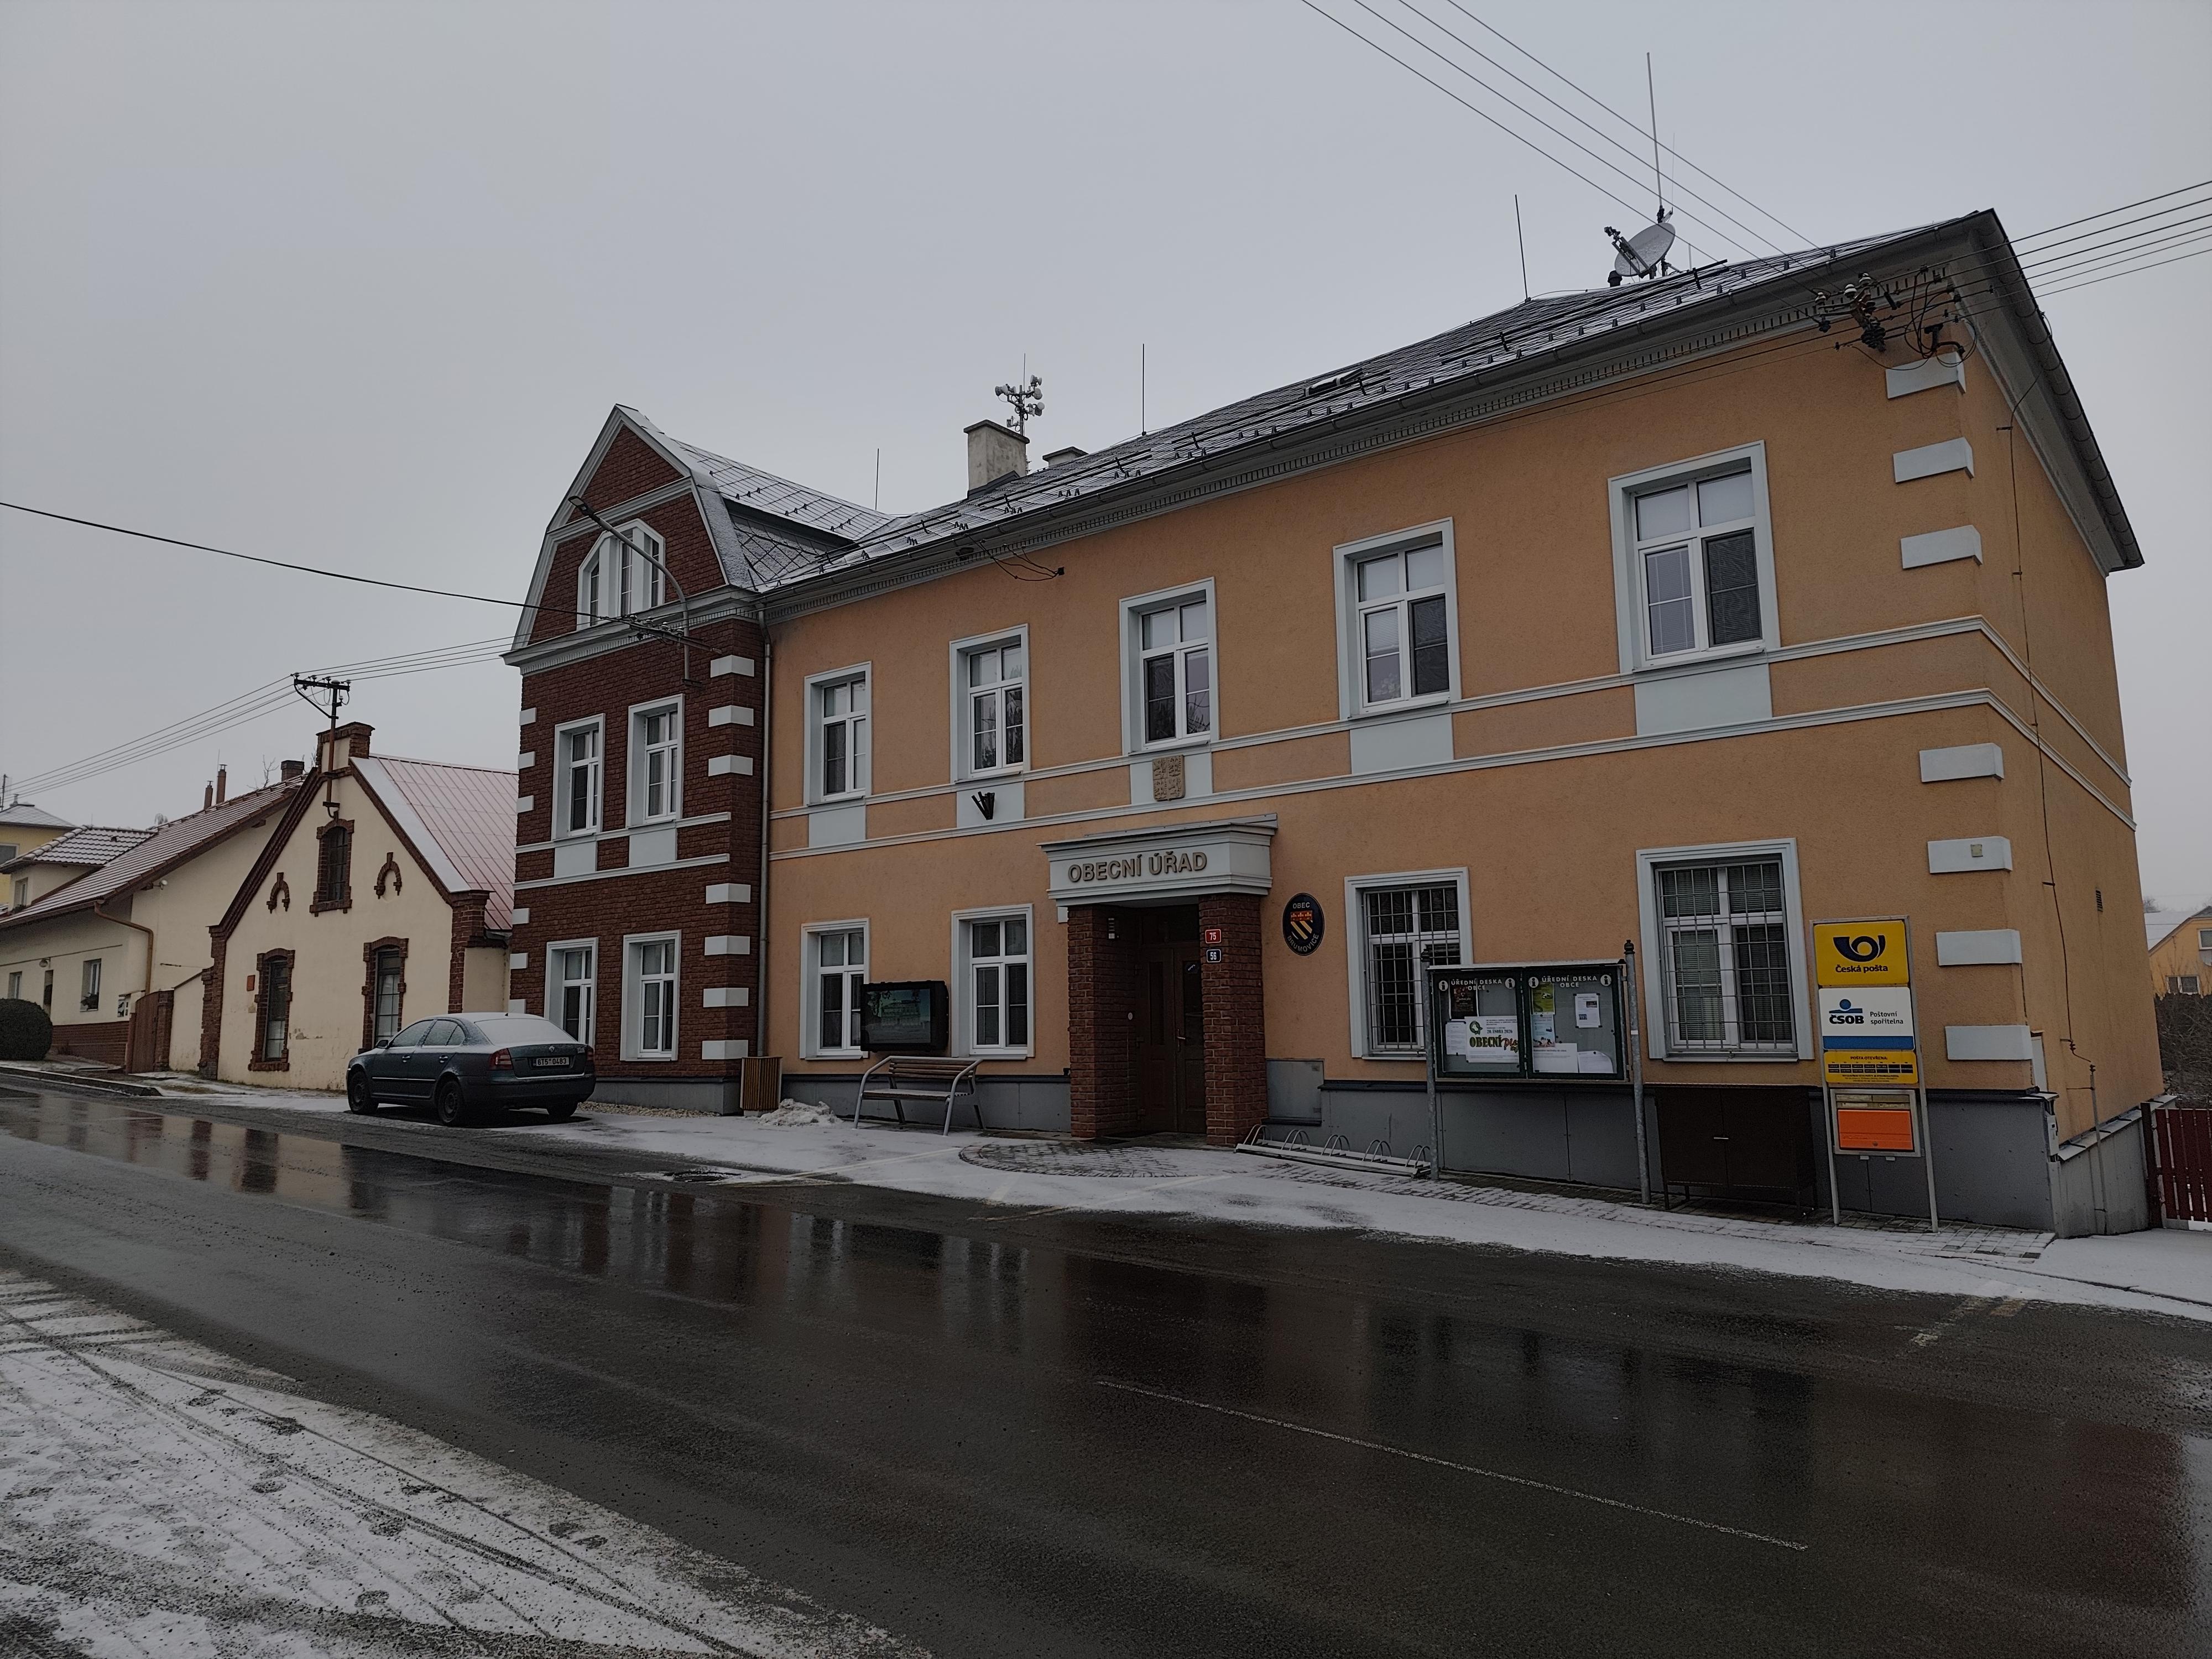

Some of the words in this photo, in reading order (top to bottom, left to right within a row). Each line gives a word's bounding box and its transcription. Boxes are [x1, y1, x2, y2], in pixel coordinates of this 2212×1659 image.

[1068, 854, 1142, 883] OBECNÍ
[1149, 851, 1207, 875] ÚŘAD
[1209, 932, 1217, 941] 75
[1287, 933, 1319, 952] BRUMOVICE
[1210, 952, 1217, 961] 56
[1835, 964, 1861, 973] Česká
[1863, 964, 1888, 974] pošta
[1829, 1014, 1864, 1025] ČSOB
[1469, 1035, 1502, 1047] OBECNÍ
